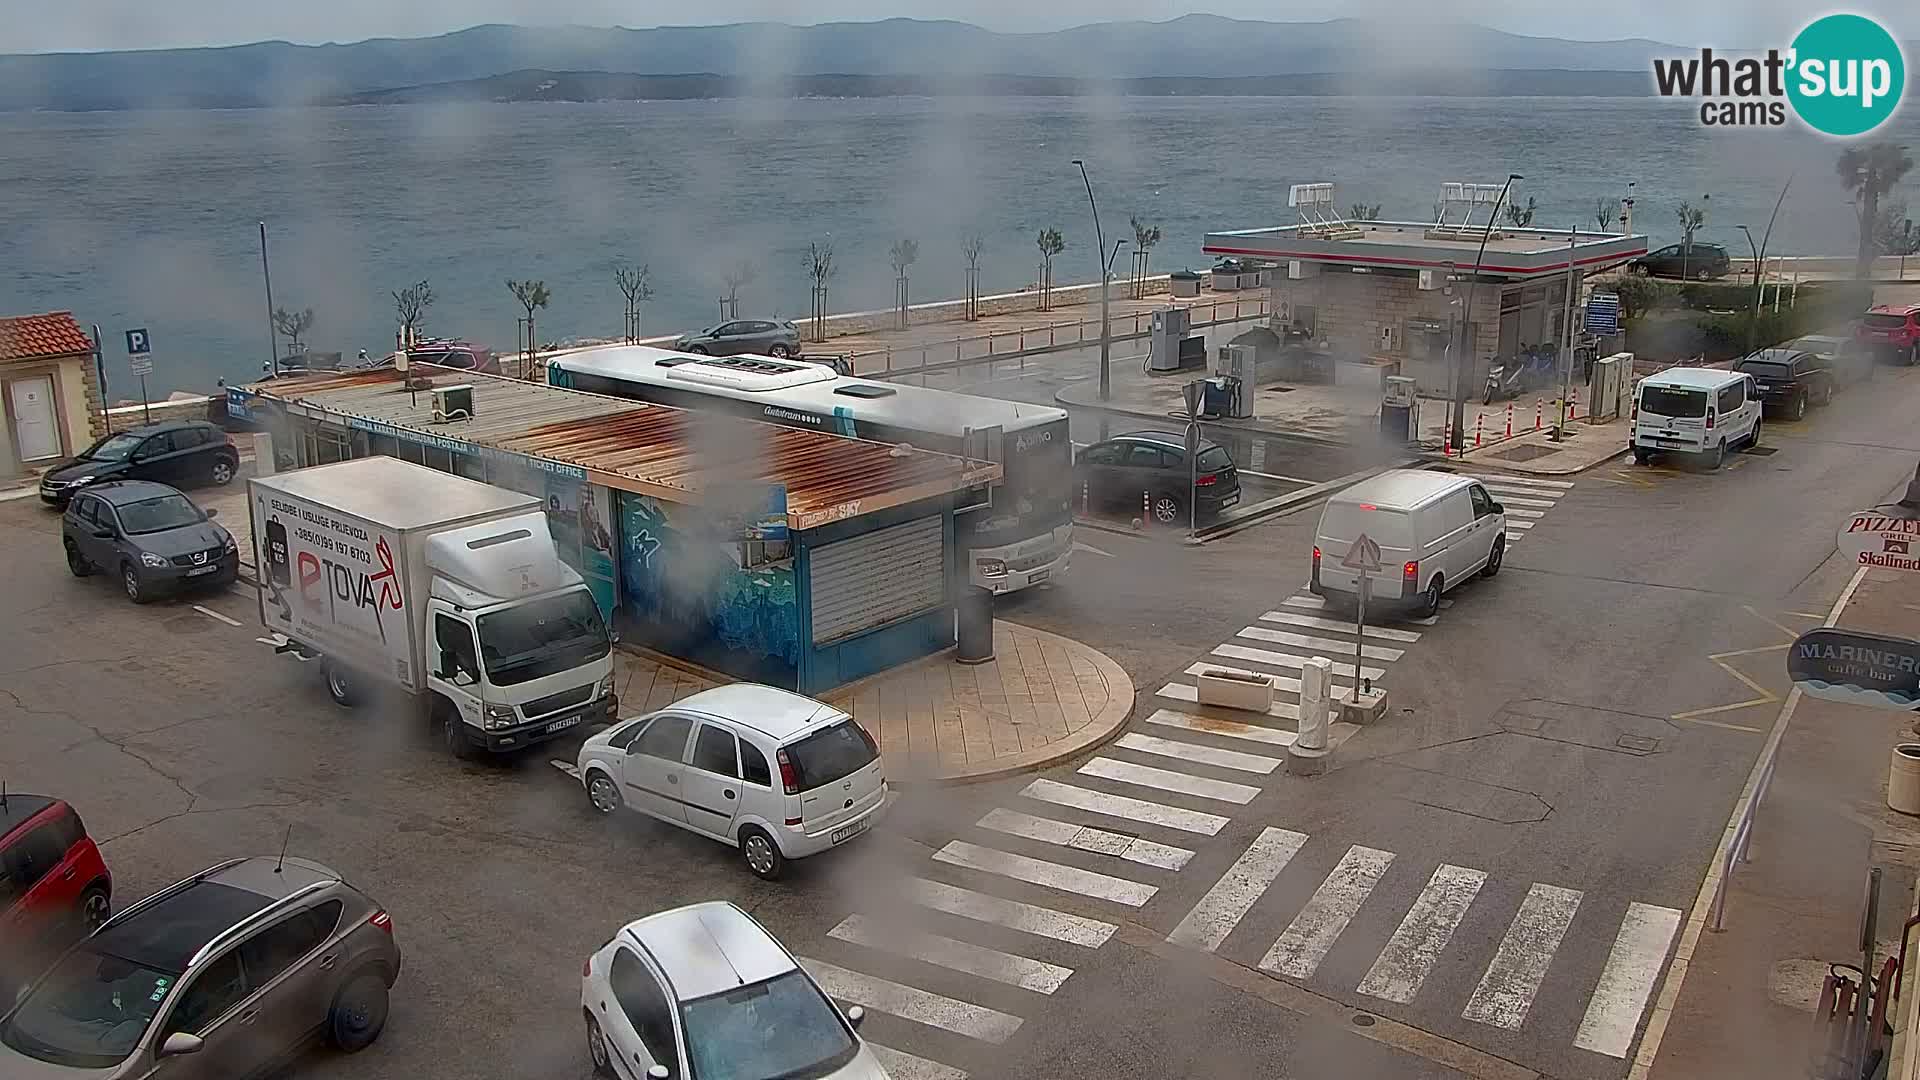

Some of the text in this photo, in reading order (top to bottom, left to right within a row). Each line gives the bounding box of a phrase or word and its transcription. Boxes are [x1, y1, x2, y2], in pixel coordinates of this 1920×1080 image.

[131, 332, 144, 351] P
[437, 437, 468, 452] POSTAJA
[529, 458, 583, 478] TICKET OFFICE
[1880, 532, 1915, 542] GRILL
[1869, 667, 1896, 681] bar
